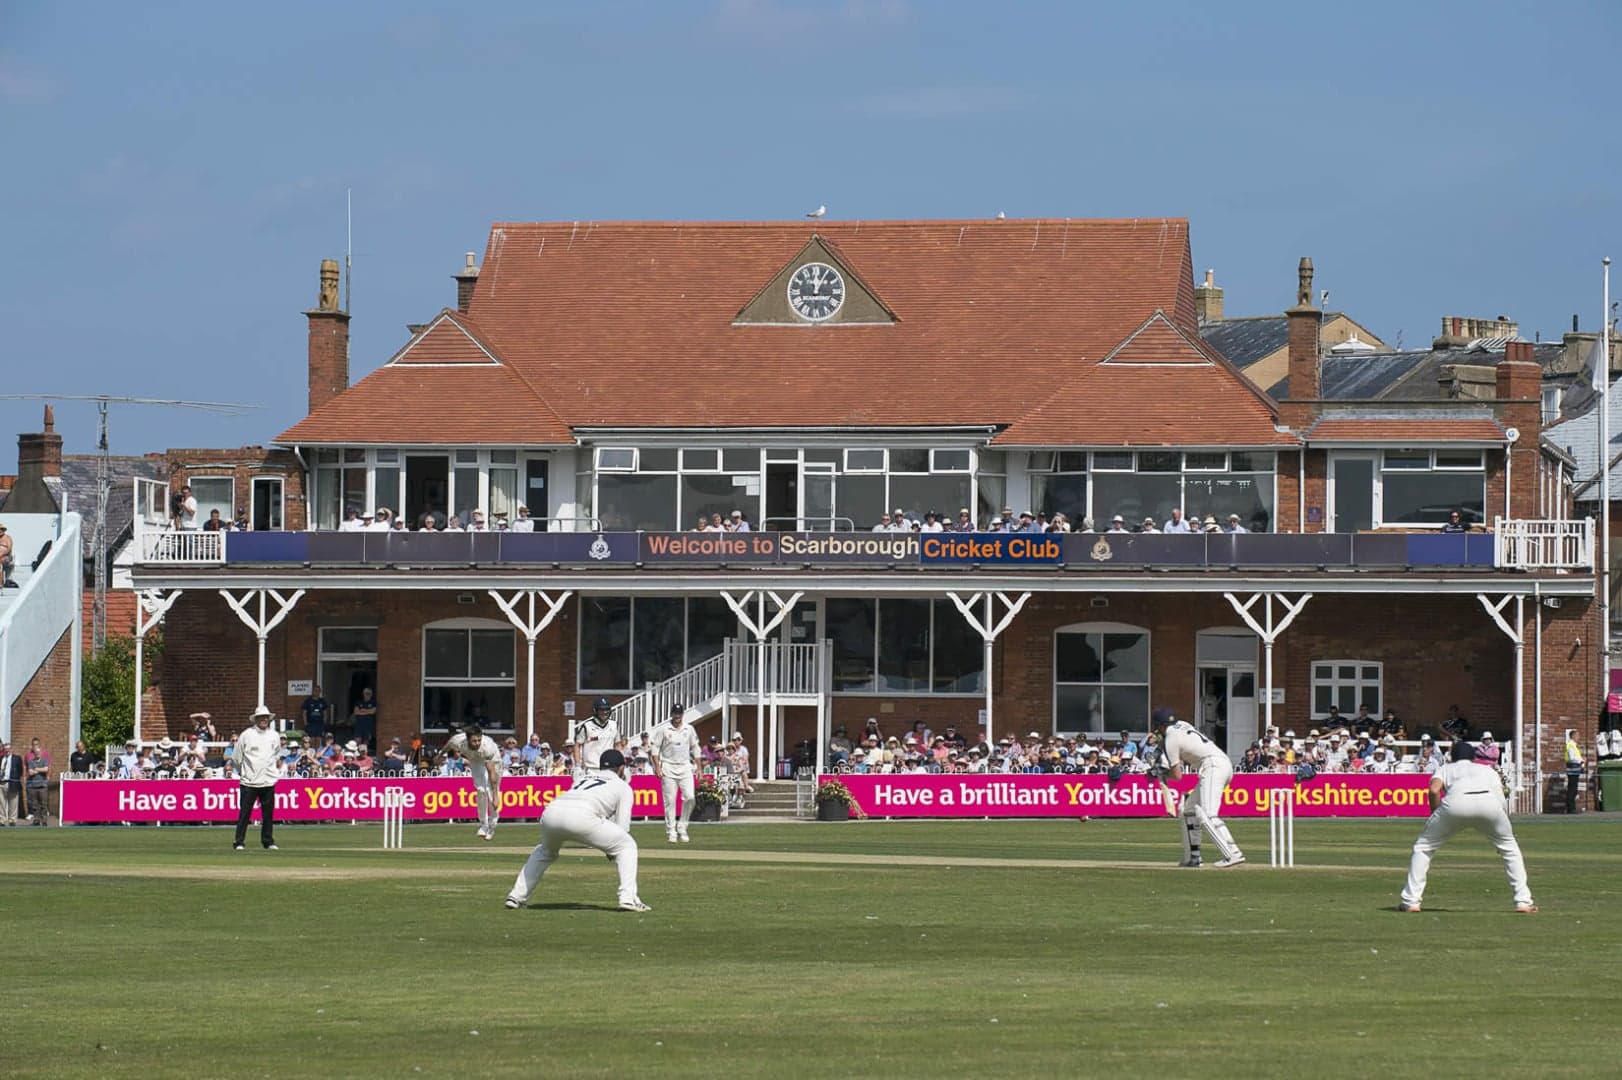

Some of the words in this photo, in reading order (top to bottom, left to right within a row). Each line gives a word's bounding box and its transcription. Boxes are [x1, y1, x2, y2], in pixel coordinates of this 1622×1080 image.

[648, 536, 747, 555] Welcome
[752, 537, 774, 555] to
[780, 536, 919, 559] Scarborough
[924, 539, 1002, 558] Cricket
[1008, 539, 1060, 558] Club
[119, 790, 177, 811] Have
[182, 794, 198, 811] a
[202, 788, 300, 810] brilnt
[423, 791, 453, 814] go
[875, 784, 934, 806] Have
[939, 788, 955, 806] a
[960, 782, 1058, 805] brilliant
[1222, 784, 1249, 805] to
